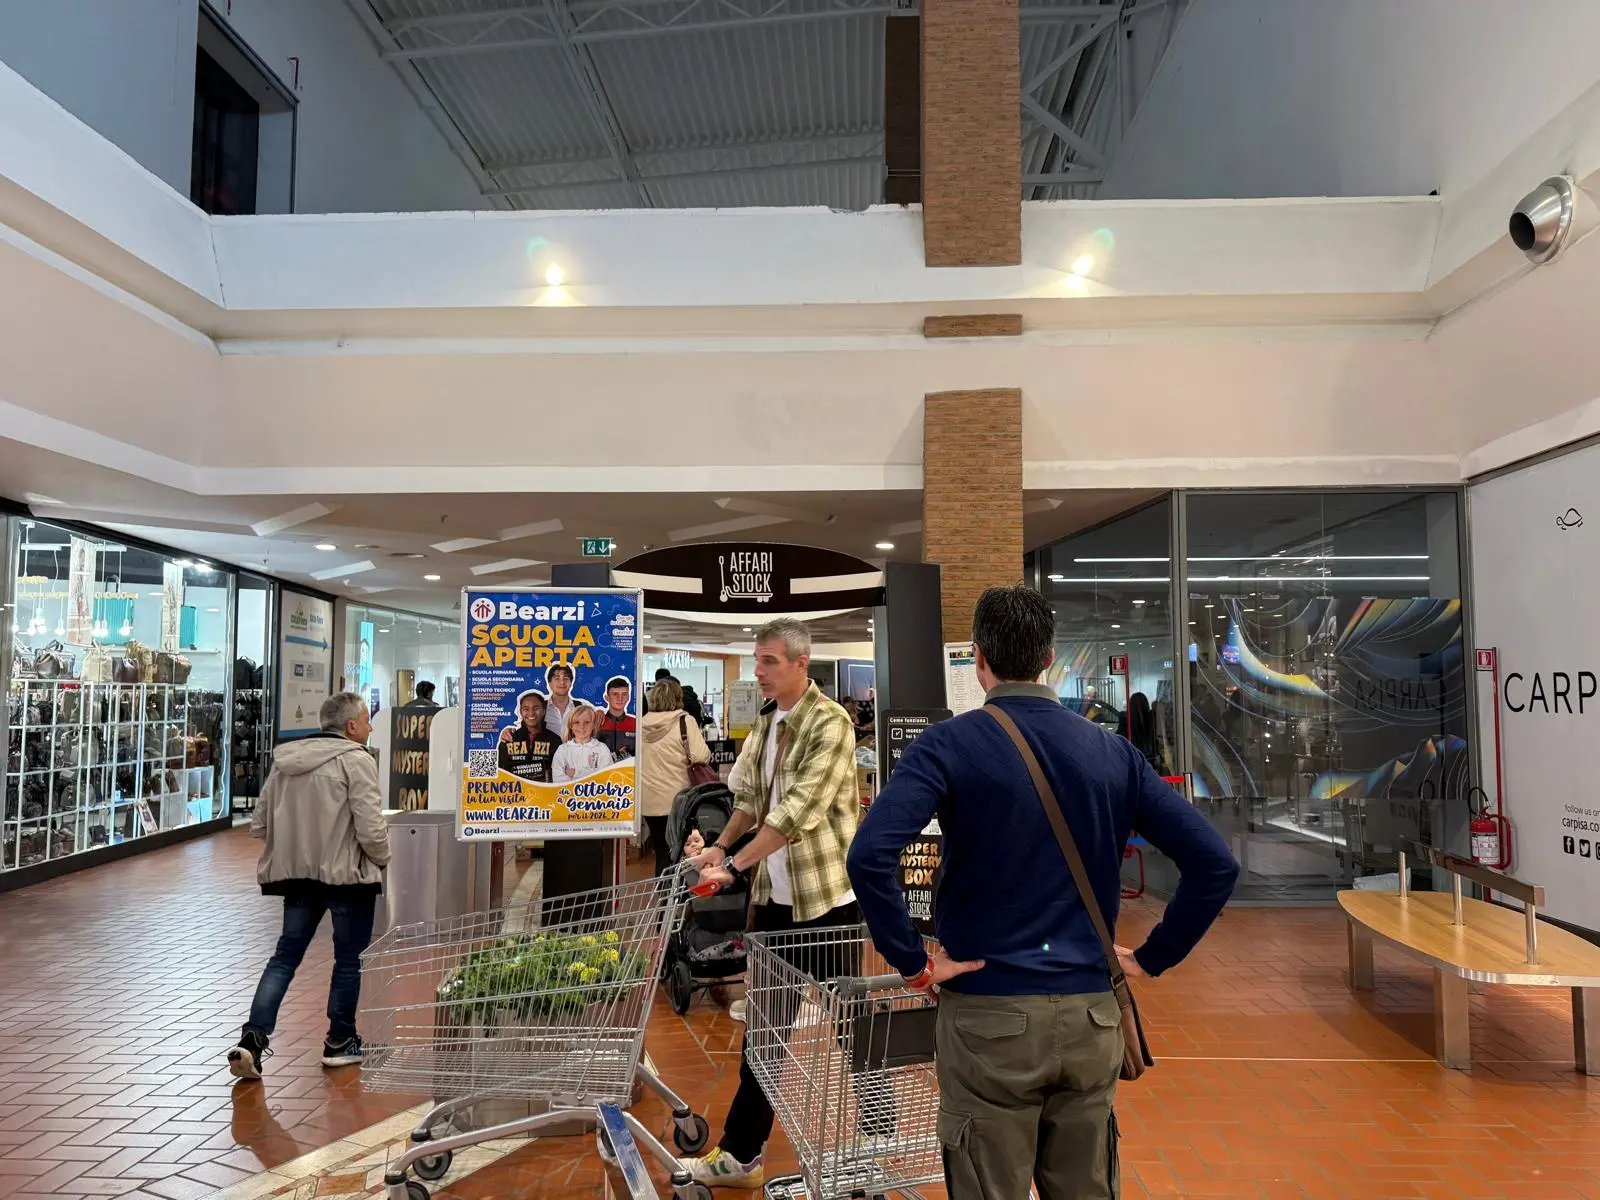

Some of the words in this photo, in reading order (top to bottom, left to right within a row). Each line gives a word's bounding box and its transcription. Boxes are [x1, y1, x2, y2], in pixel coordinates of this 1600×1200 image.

[730, 552, 772, 572] AFFARI
[732, 573, 772, 592] STOCK
[500, 600, 584, 622] Bearzi
[472, 624, 596, 646] SCUOLA
[470, 647, 594, 668] APERTA
[1504, 671, 1598, 714] CARP
[392, 750, 430, 776] MYSTER
[710, 752, 735, 763] SCITA
[468, 781, 522, 794] PRENOTA
[399, 787, 428, 810] BOX
[467, 794, 477, 804] la
[479, 794, 497, 803] tua
[499, 794, 526, 804] visita
[901, 842, 938, 855] UPER
[904, 868, 933, 886] BOX
[908, 890, 931, 902] AFFARI
[910, 902, 931, 914] STOCK
